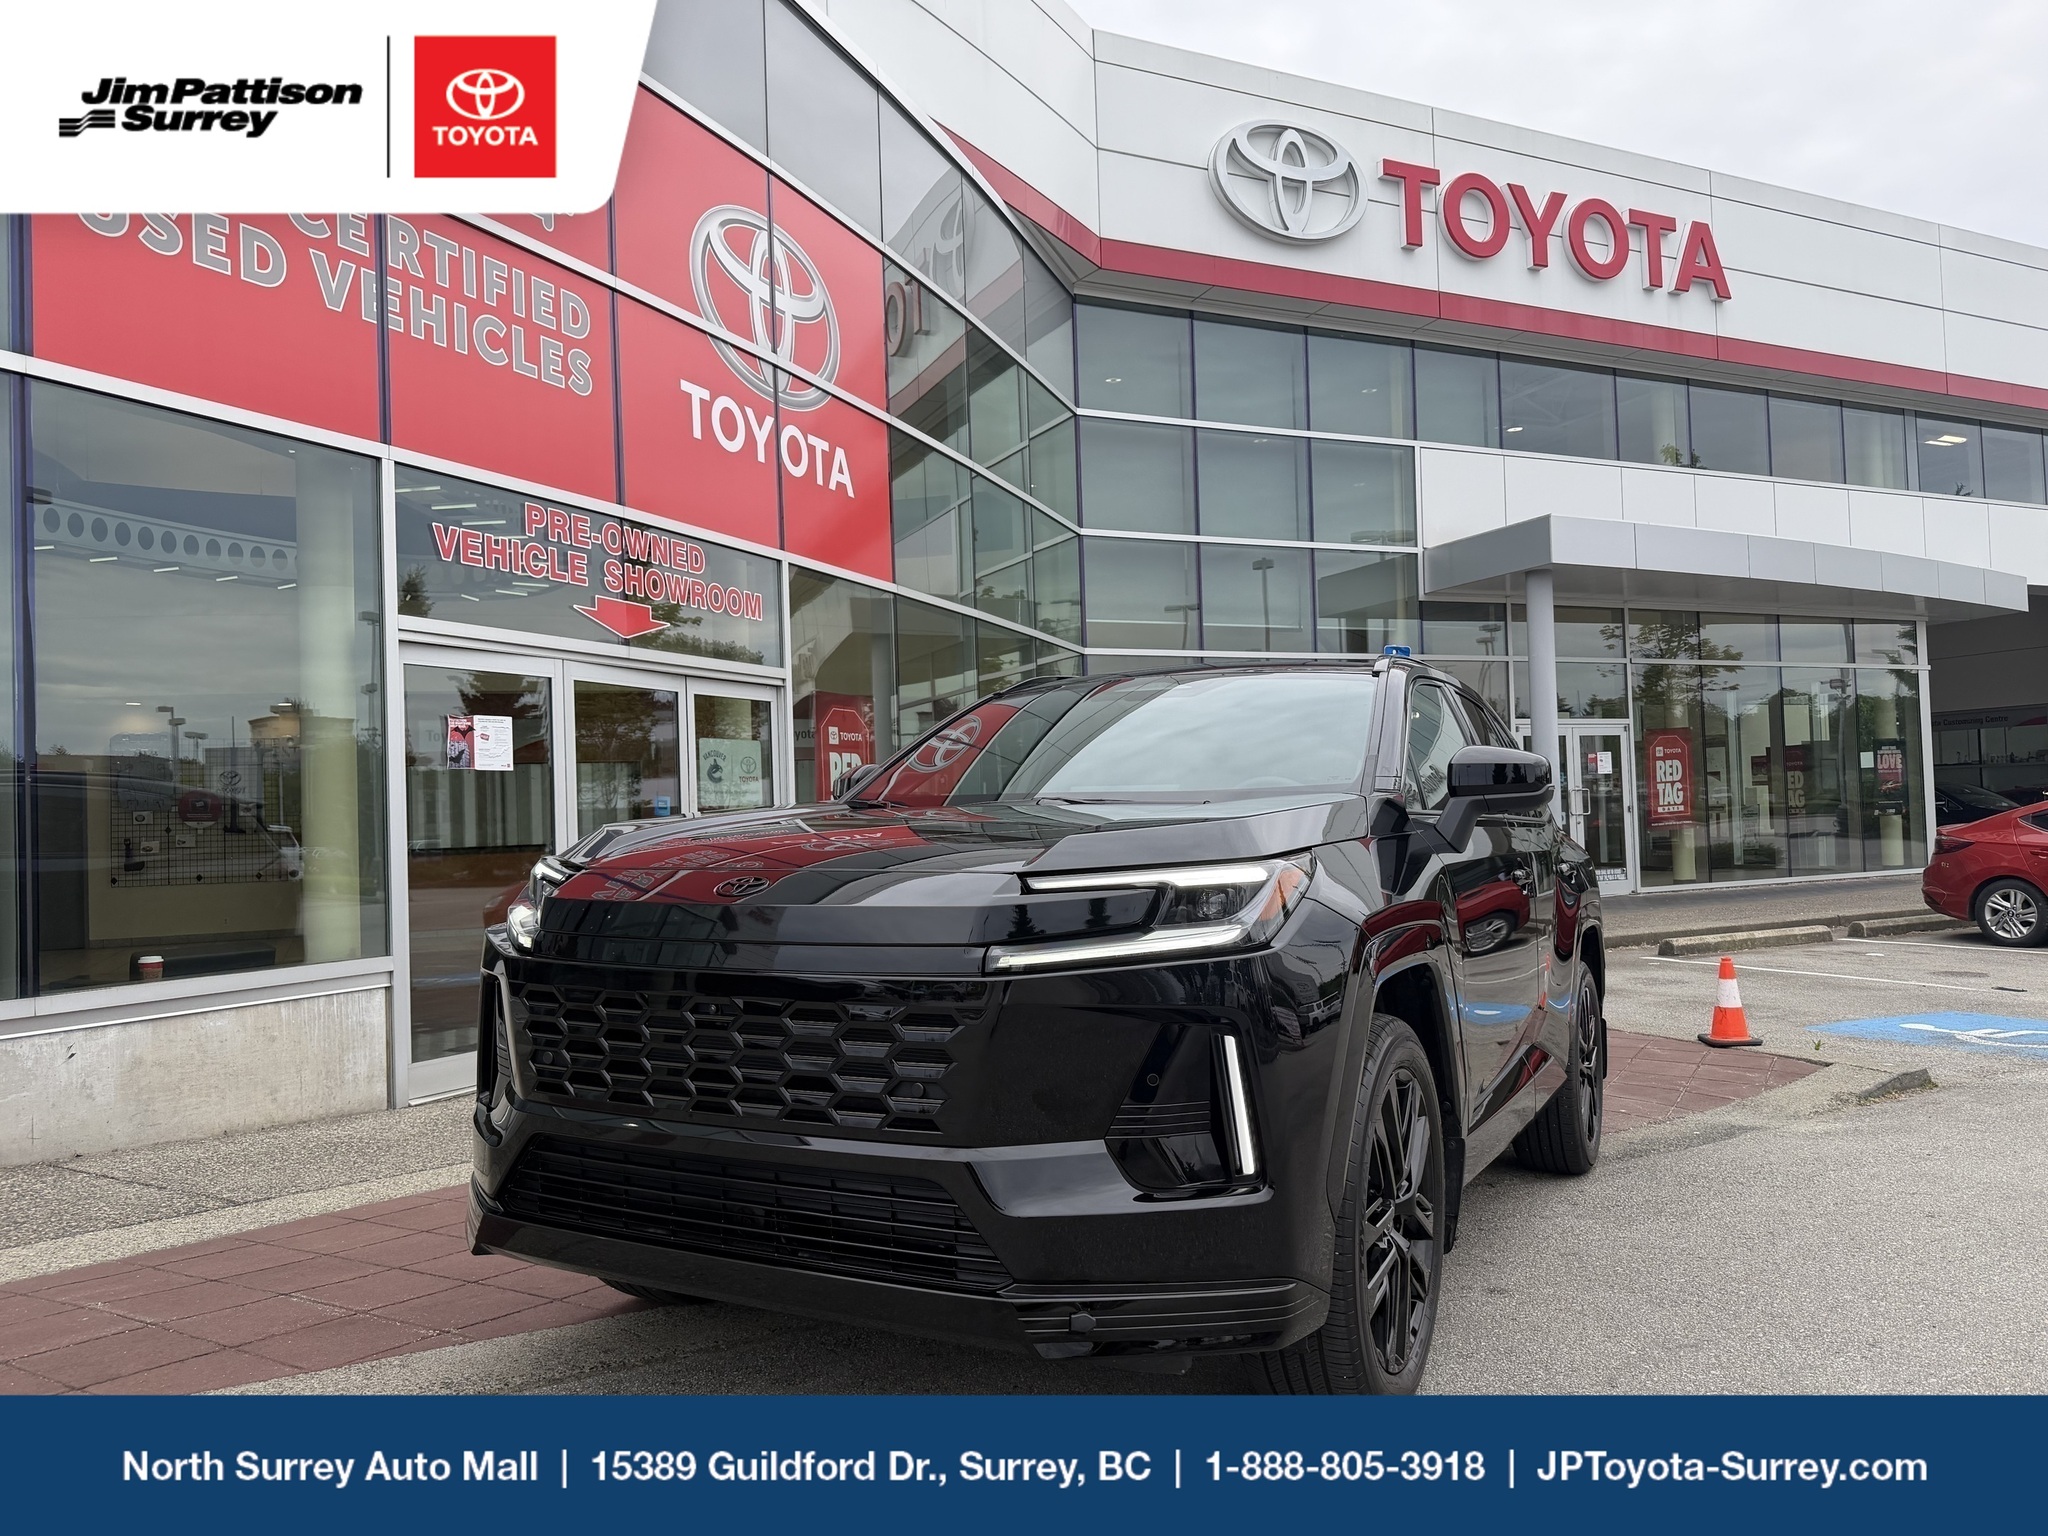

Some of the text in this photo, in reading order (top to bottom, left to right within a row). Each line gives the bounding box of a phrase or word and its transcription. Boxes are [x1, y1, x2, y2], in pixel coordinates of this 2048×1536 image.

[1377, 157, 1733, 303] TOYOTA
[308, 247, 593, 397] VEHICLES
[679, 378, 855, 499] TOYOTA
[524, 501, 706, 575] PRE-OWNED
[432, 521, 763, 622] VEHICLE SHOWROOM
[839, 731, 863, 742] TOYOTA
[702, 749, 727, 762] VANCOUVER
[1877, 754, 1902, 769] LOVE
[738, 775, 760, 783] TOYOTA
[1656, 759, 1682, 782] RED
[1657, 782, 1683, 805] TAG
